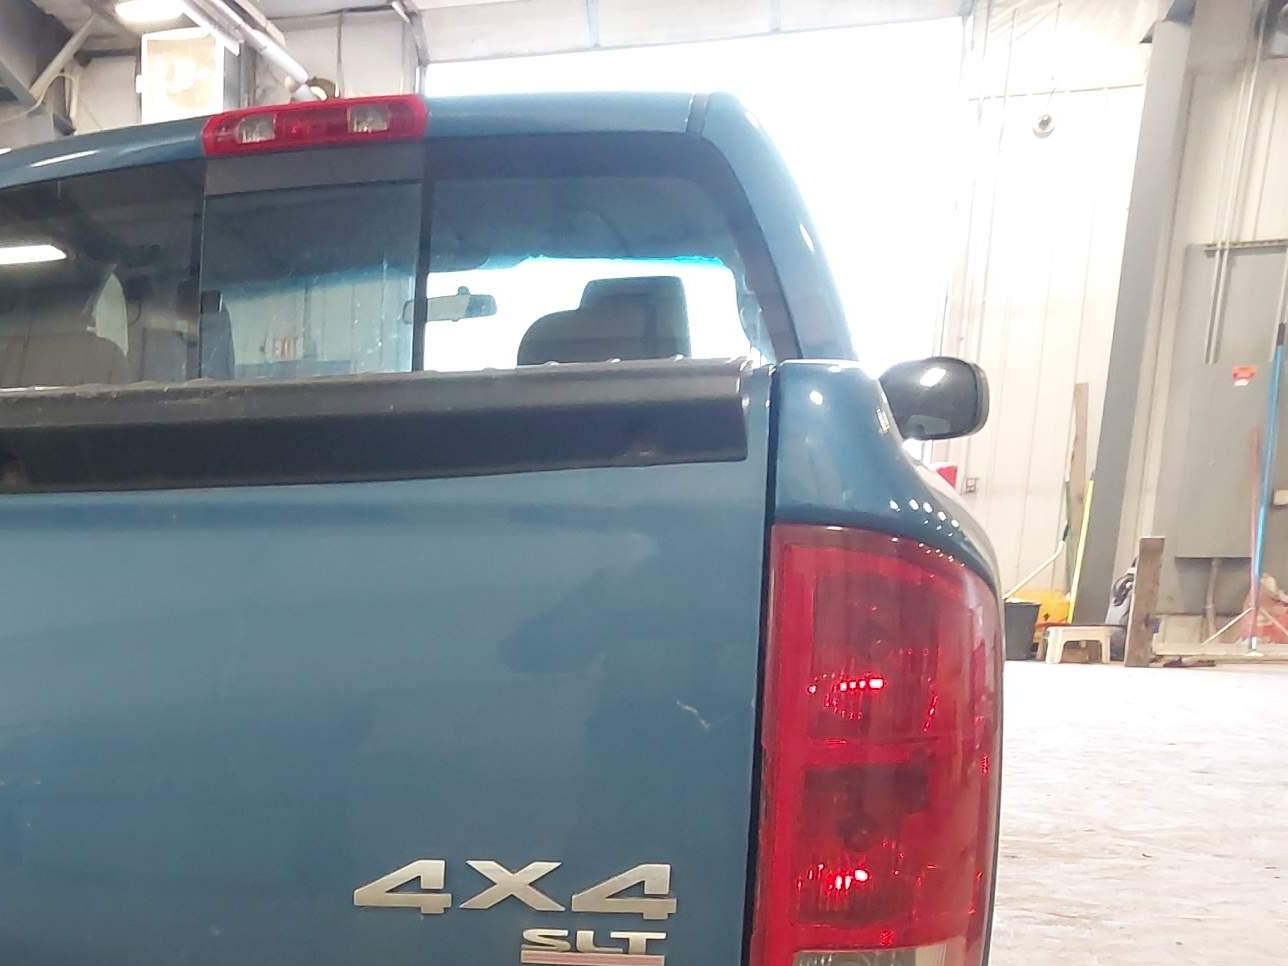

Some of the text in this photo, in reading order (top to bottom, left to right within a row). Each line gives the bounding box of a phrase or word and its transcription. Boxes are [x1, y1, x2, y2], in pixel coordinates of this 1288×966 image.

[272, 336, 298, 360] EXIT
[353, 859, 677, 920] 4X4
[521, 929, 667, 955] SLT
